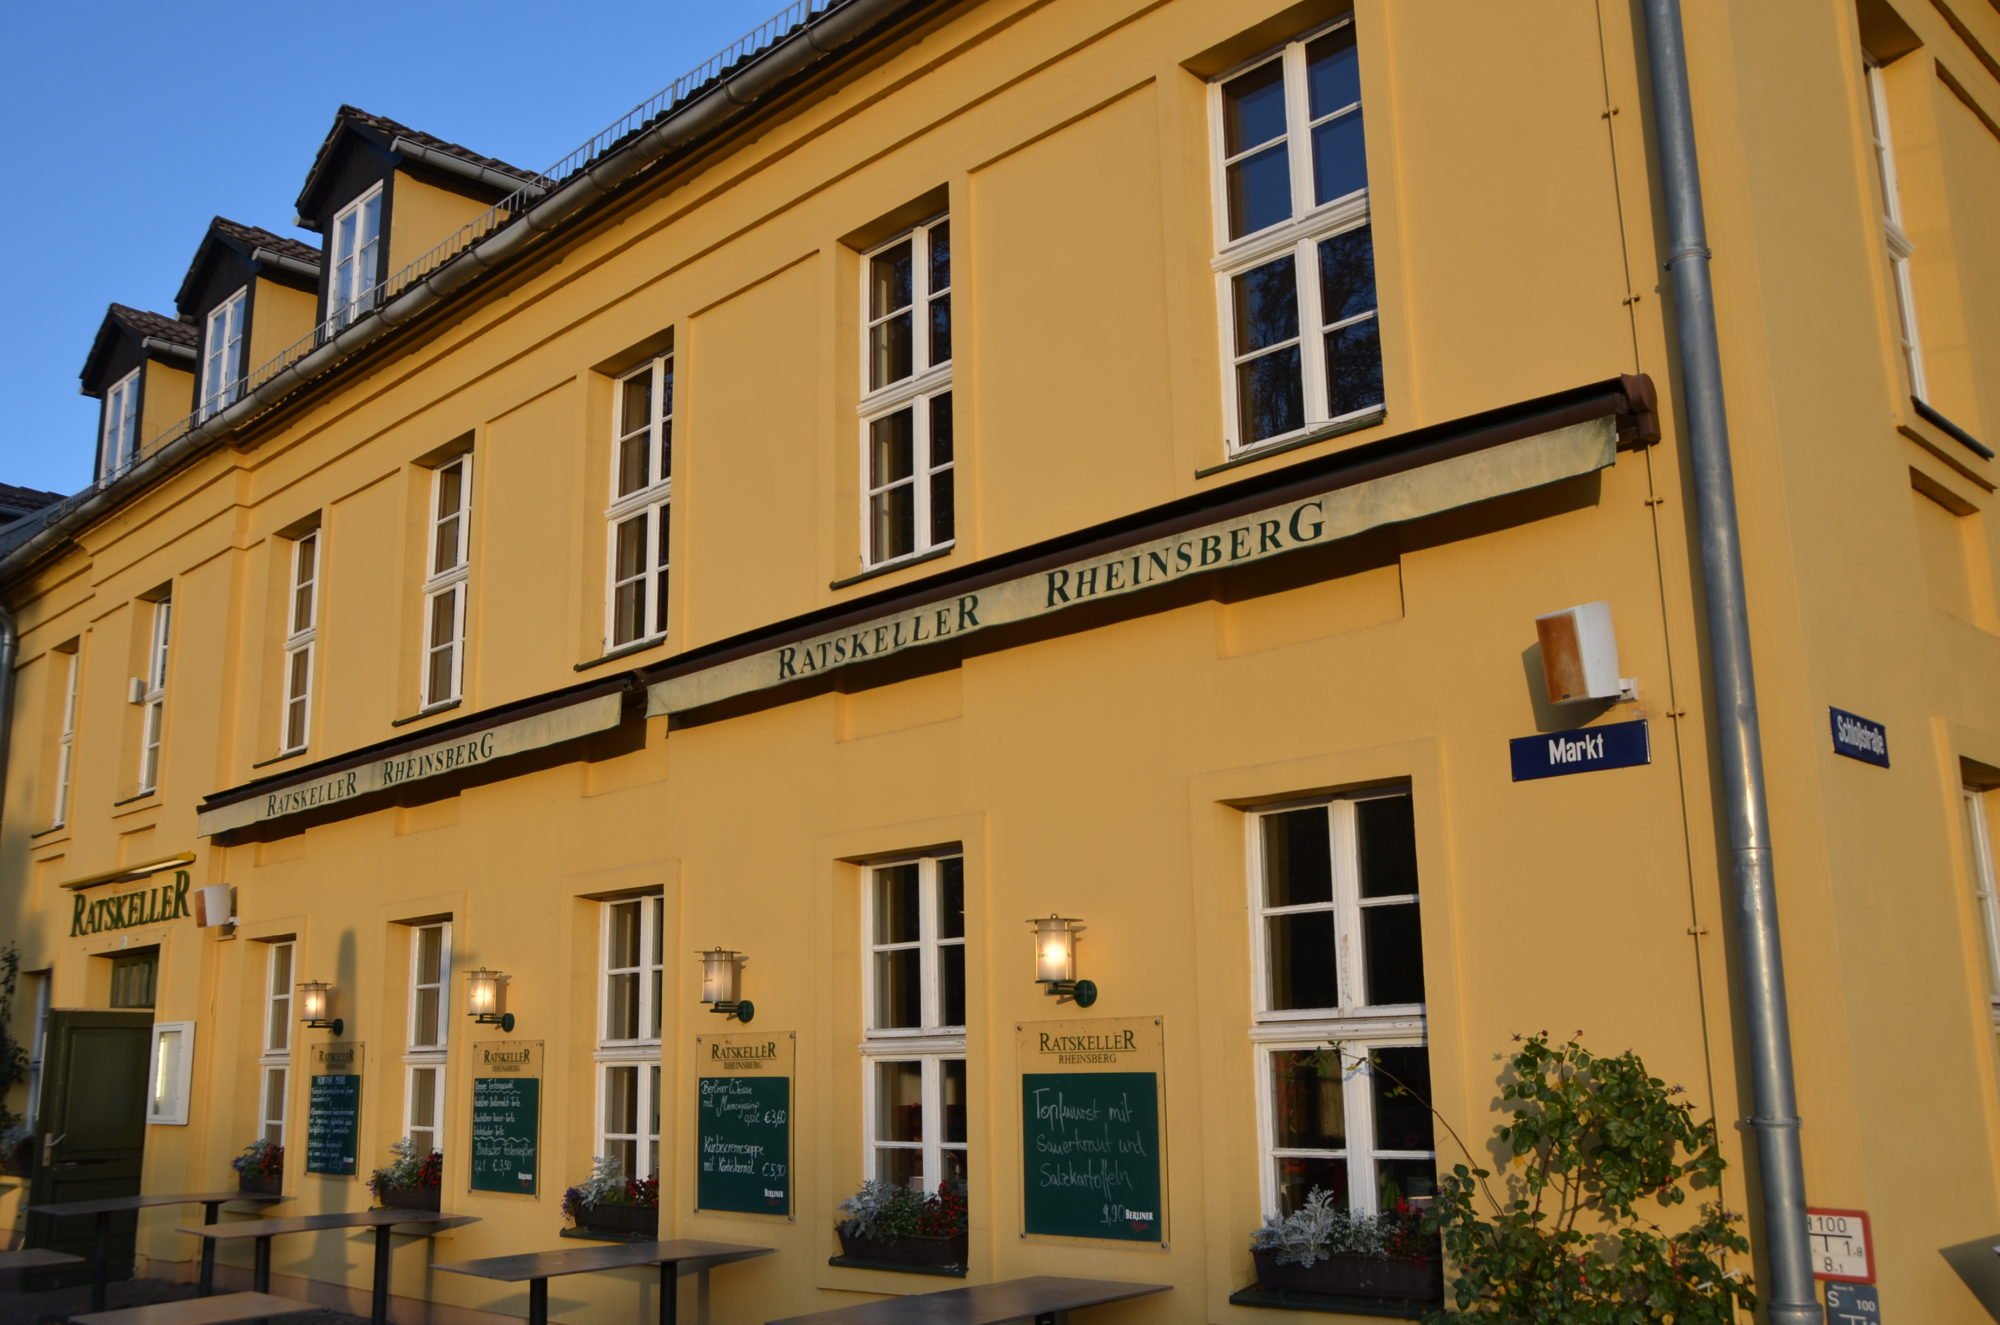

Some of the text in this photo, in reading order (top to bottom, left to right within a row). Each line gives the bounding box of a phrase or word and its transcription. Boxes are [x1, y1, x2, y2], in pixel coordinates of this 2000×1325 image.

[778, 501, 1325, 680] RATSKELLER RHEINSBERG
[1548, 733, 1604, 765] Markt
[1837, 714, 1884, 755] Schloßstraße
[267, 732, 494, 817] RATSKELLER RHEINSBERG
[69, 870, 191, 938] RATSKELLER
[483, 1048, 530, 1063] RATSKELLER
[711, 1041, 776, 1059] RATSKELLER
[1039, 1029, 1136, 1051] RATSKELLER
[1058, 1053, 1117, 1064] RHEINSBERG
[701, 1079, 728, 1095] Berliner
[1033, 1087, 1133, 1133] Topfwurst mit
[1037, 1122, 1148, 1157] Sauerkraut und
[1040, 1158, 1134, 1201] Salzkartoffeln
[1125, 1208, 1154, 1221] BERLINER
[1827, 1290, 1876, 1312] S 100
